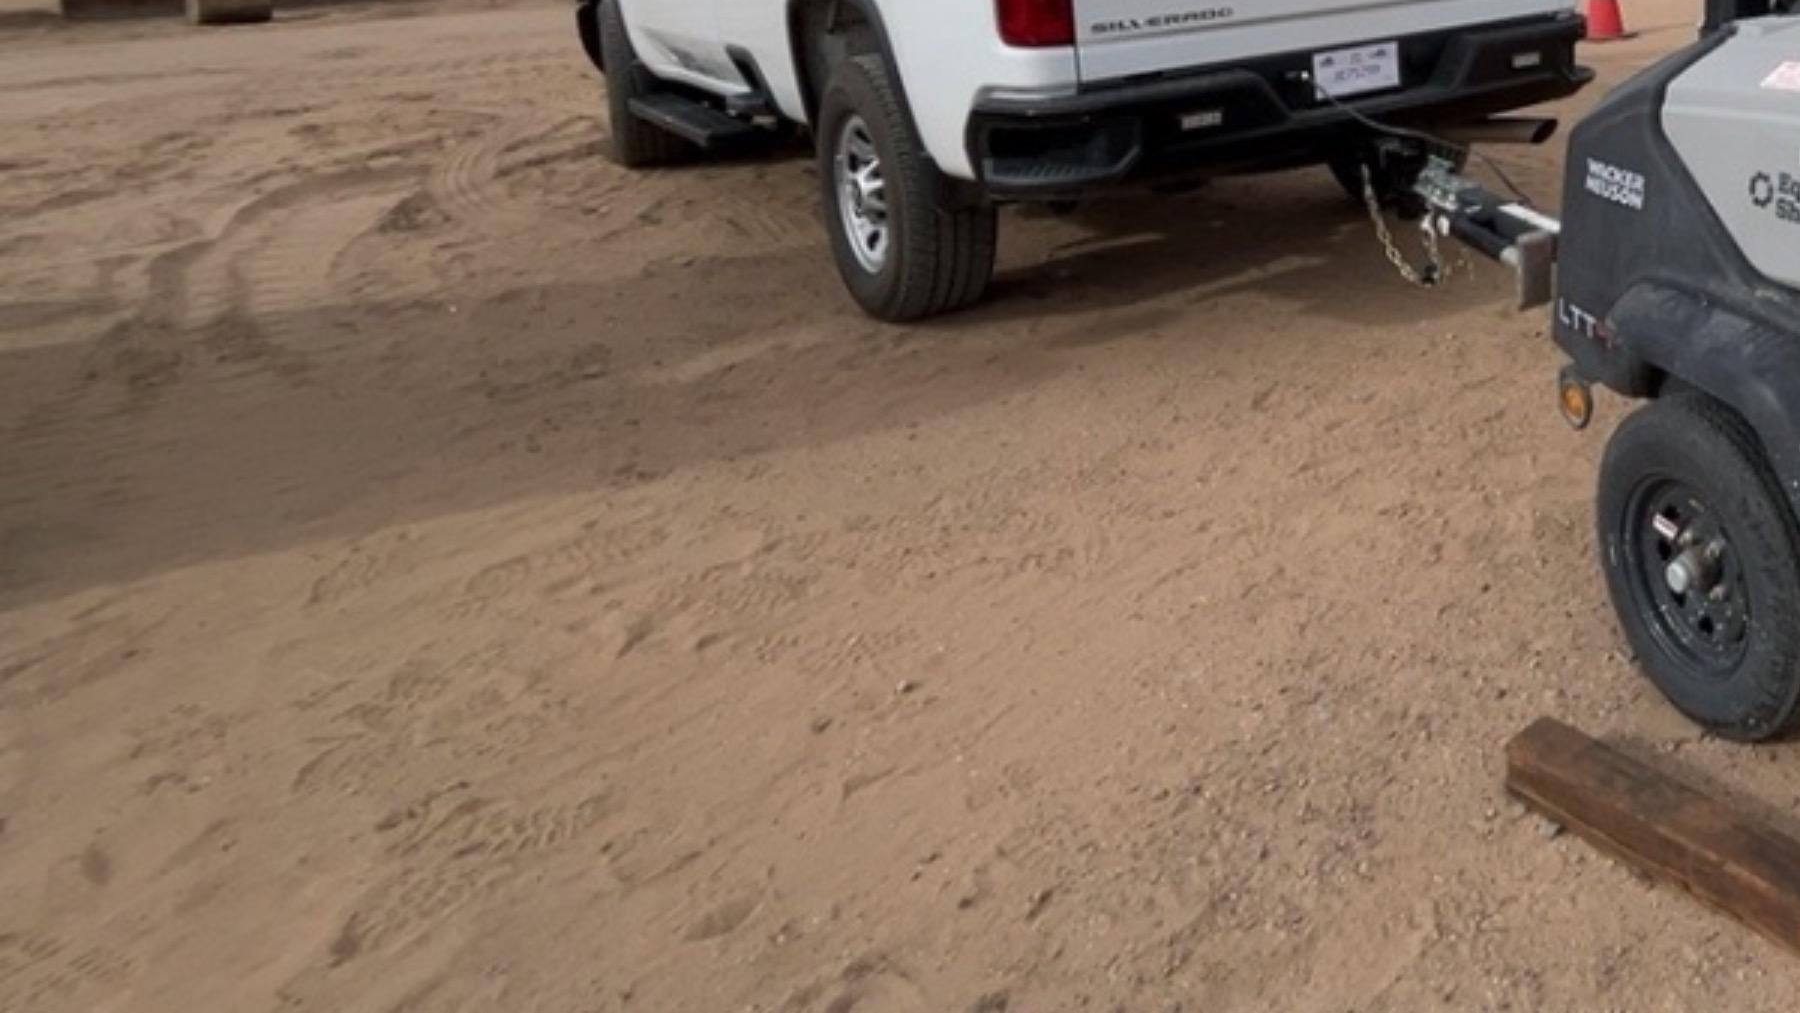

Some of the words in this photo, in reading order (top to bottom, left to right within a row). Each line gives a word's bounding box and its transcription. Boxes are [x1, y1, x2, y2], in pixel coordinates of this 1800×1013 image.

[1090, 6, 1234, 35] SILVERADO
[1586, 156, 1645, 189] WACKER
[1585, 174, 1645, 211] NEUSON
